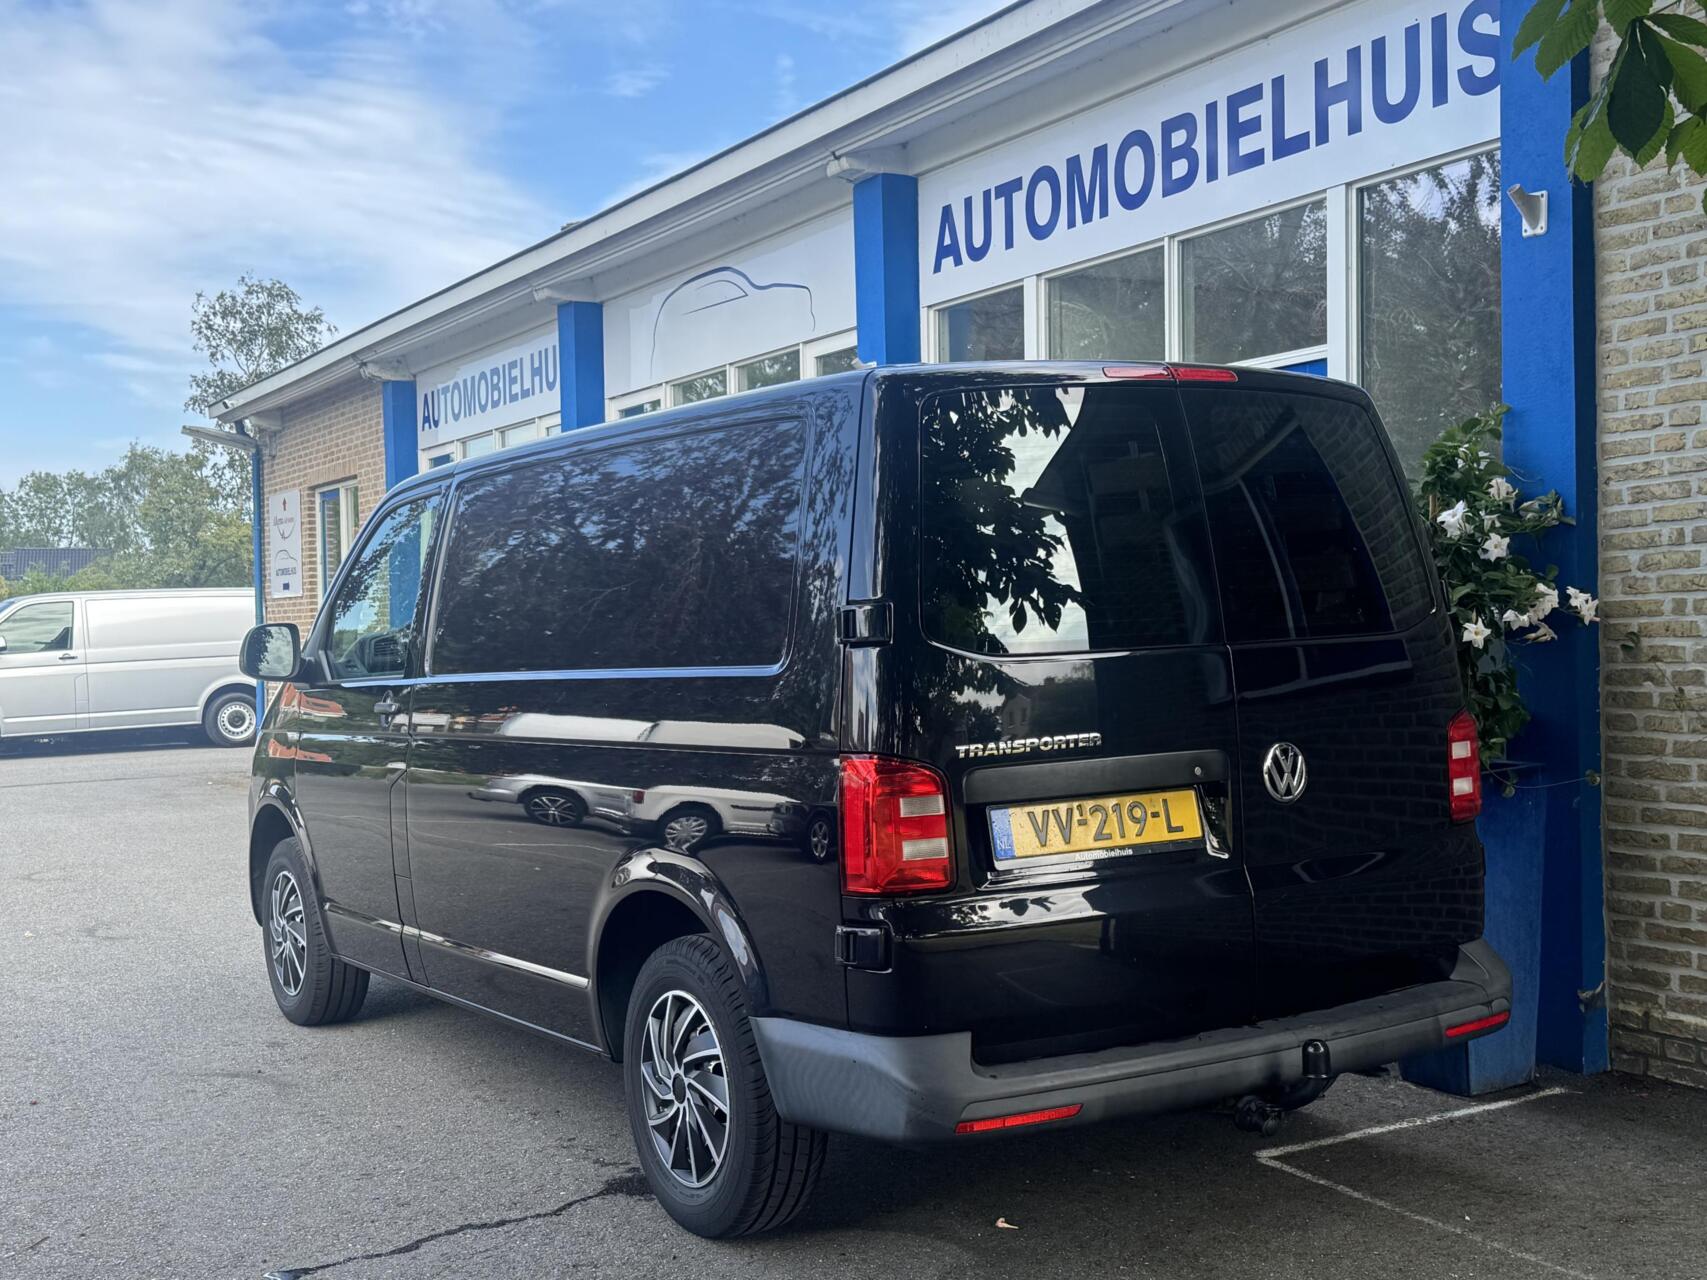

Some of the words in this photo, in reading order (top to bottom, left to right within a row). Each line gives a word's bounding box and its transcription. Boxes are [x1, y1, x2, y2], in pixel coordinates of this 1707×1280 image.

[932, 0, 1501, 275] AUTOMOBIELHUIS
[422, 345, 558, 432] AUTOMOBIELHU
[955, 732, 1102, 759] TRANSPORTER
[996, 837, 1011, 849] NL
